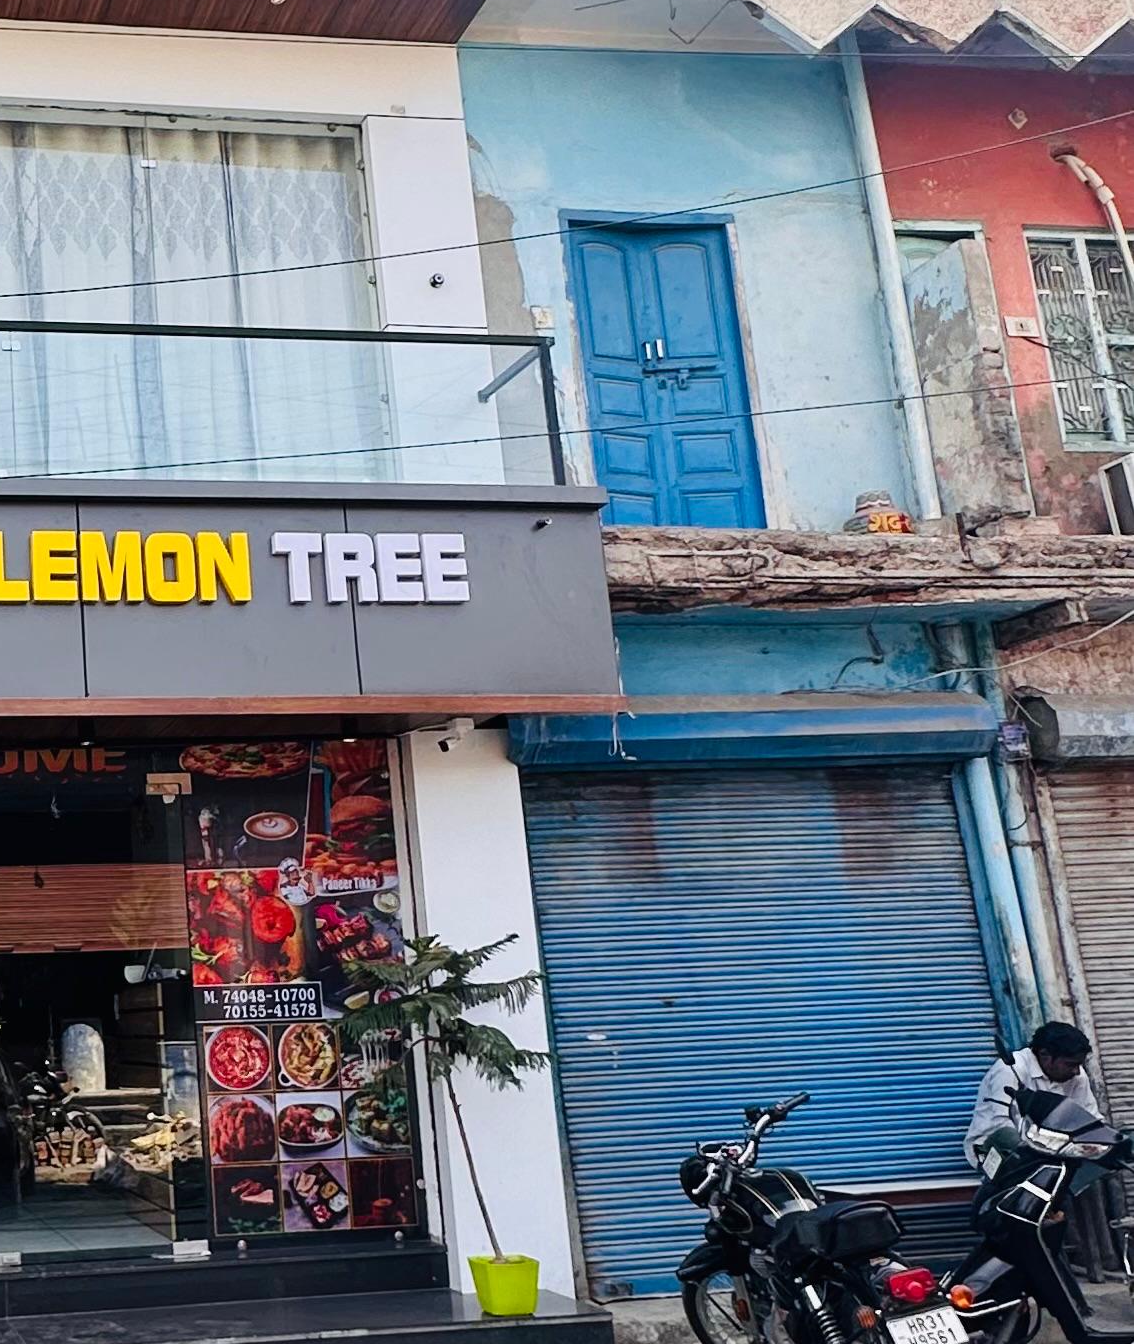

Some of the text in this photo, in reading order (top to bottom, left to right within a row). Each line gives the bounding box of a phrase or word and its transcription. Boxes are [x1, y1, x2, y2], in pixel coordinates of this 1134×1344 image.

[270, 530, 471, 605] TREE
[322, 876, 353, 891] Paneer
[203, 987, 317, 1005] M. 74048-10700
[222, 1003, 318, 1019] 70155-41578
[906, 1313, 947, 1335] HR31
